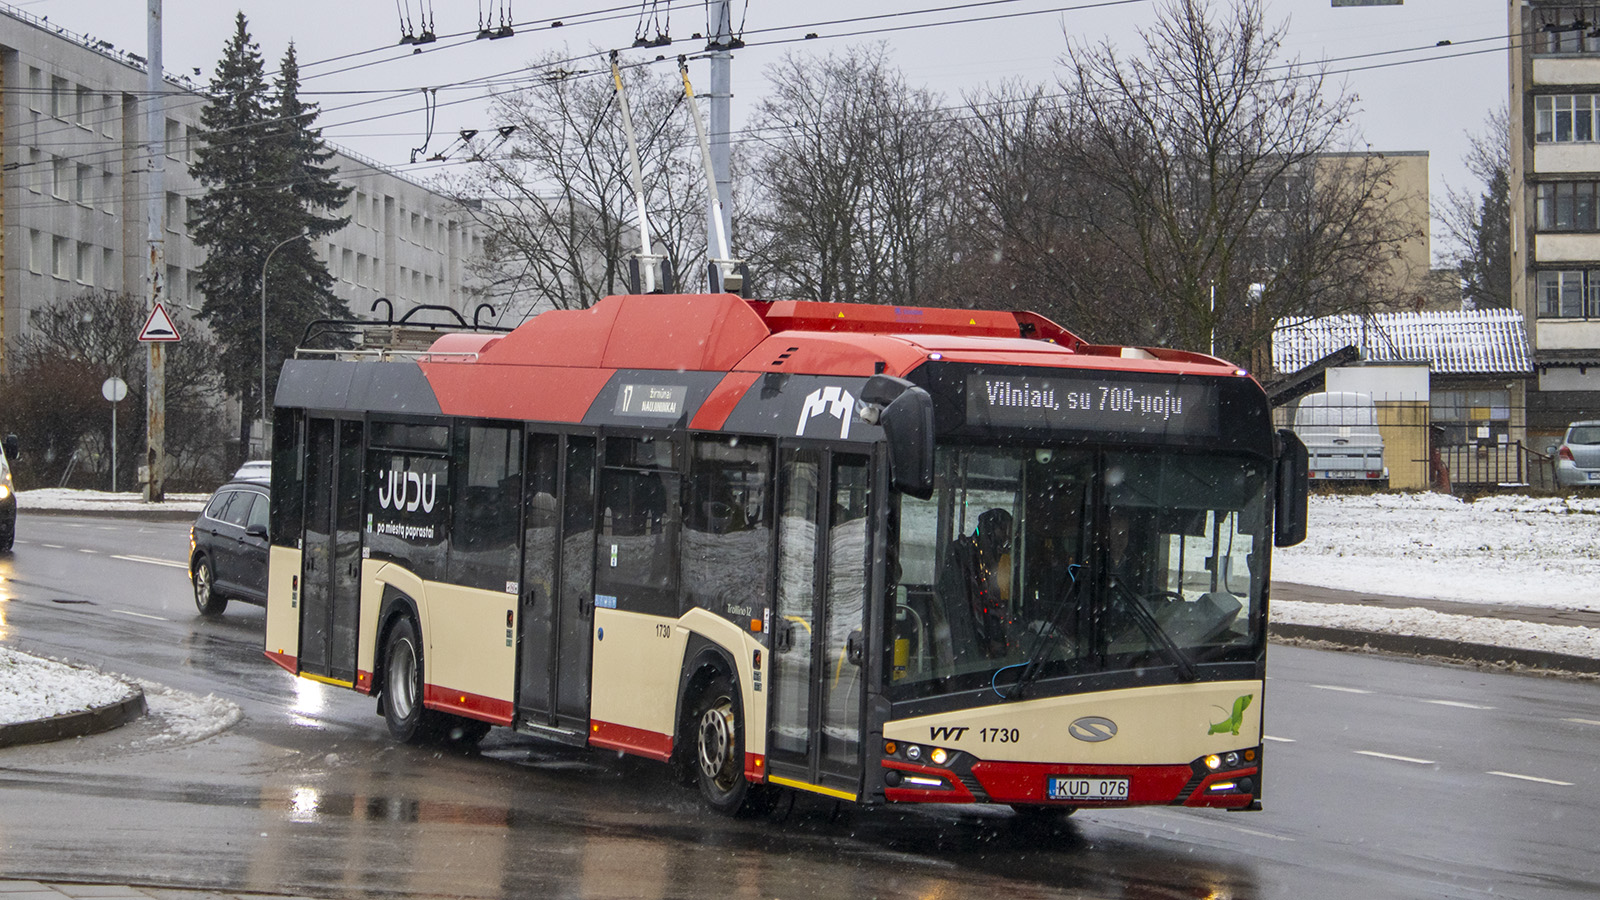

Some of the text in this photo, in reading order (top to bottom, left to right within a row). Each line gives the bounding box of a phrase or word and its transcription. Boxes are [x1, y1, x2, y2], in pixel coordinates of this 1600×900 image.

[622, 385, 634, 412] 17
[1067, 392, 1091, 410] su
[1098, 386, 1182, 421] 700-uoju
[379, 469, 436, 514] JUDU
[377, 523, 385, 535] po
[405, 524, 434, 540] paprastai
[727, 603, 752, 617] Trollino 12
[655, 623, 671, 638] 1730
[930, 726, 1020, 743] VVT 1730
[1058, 781, 1126, 796] KUD 076
